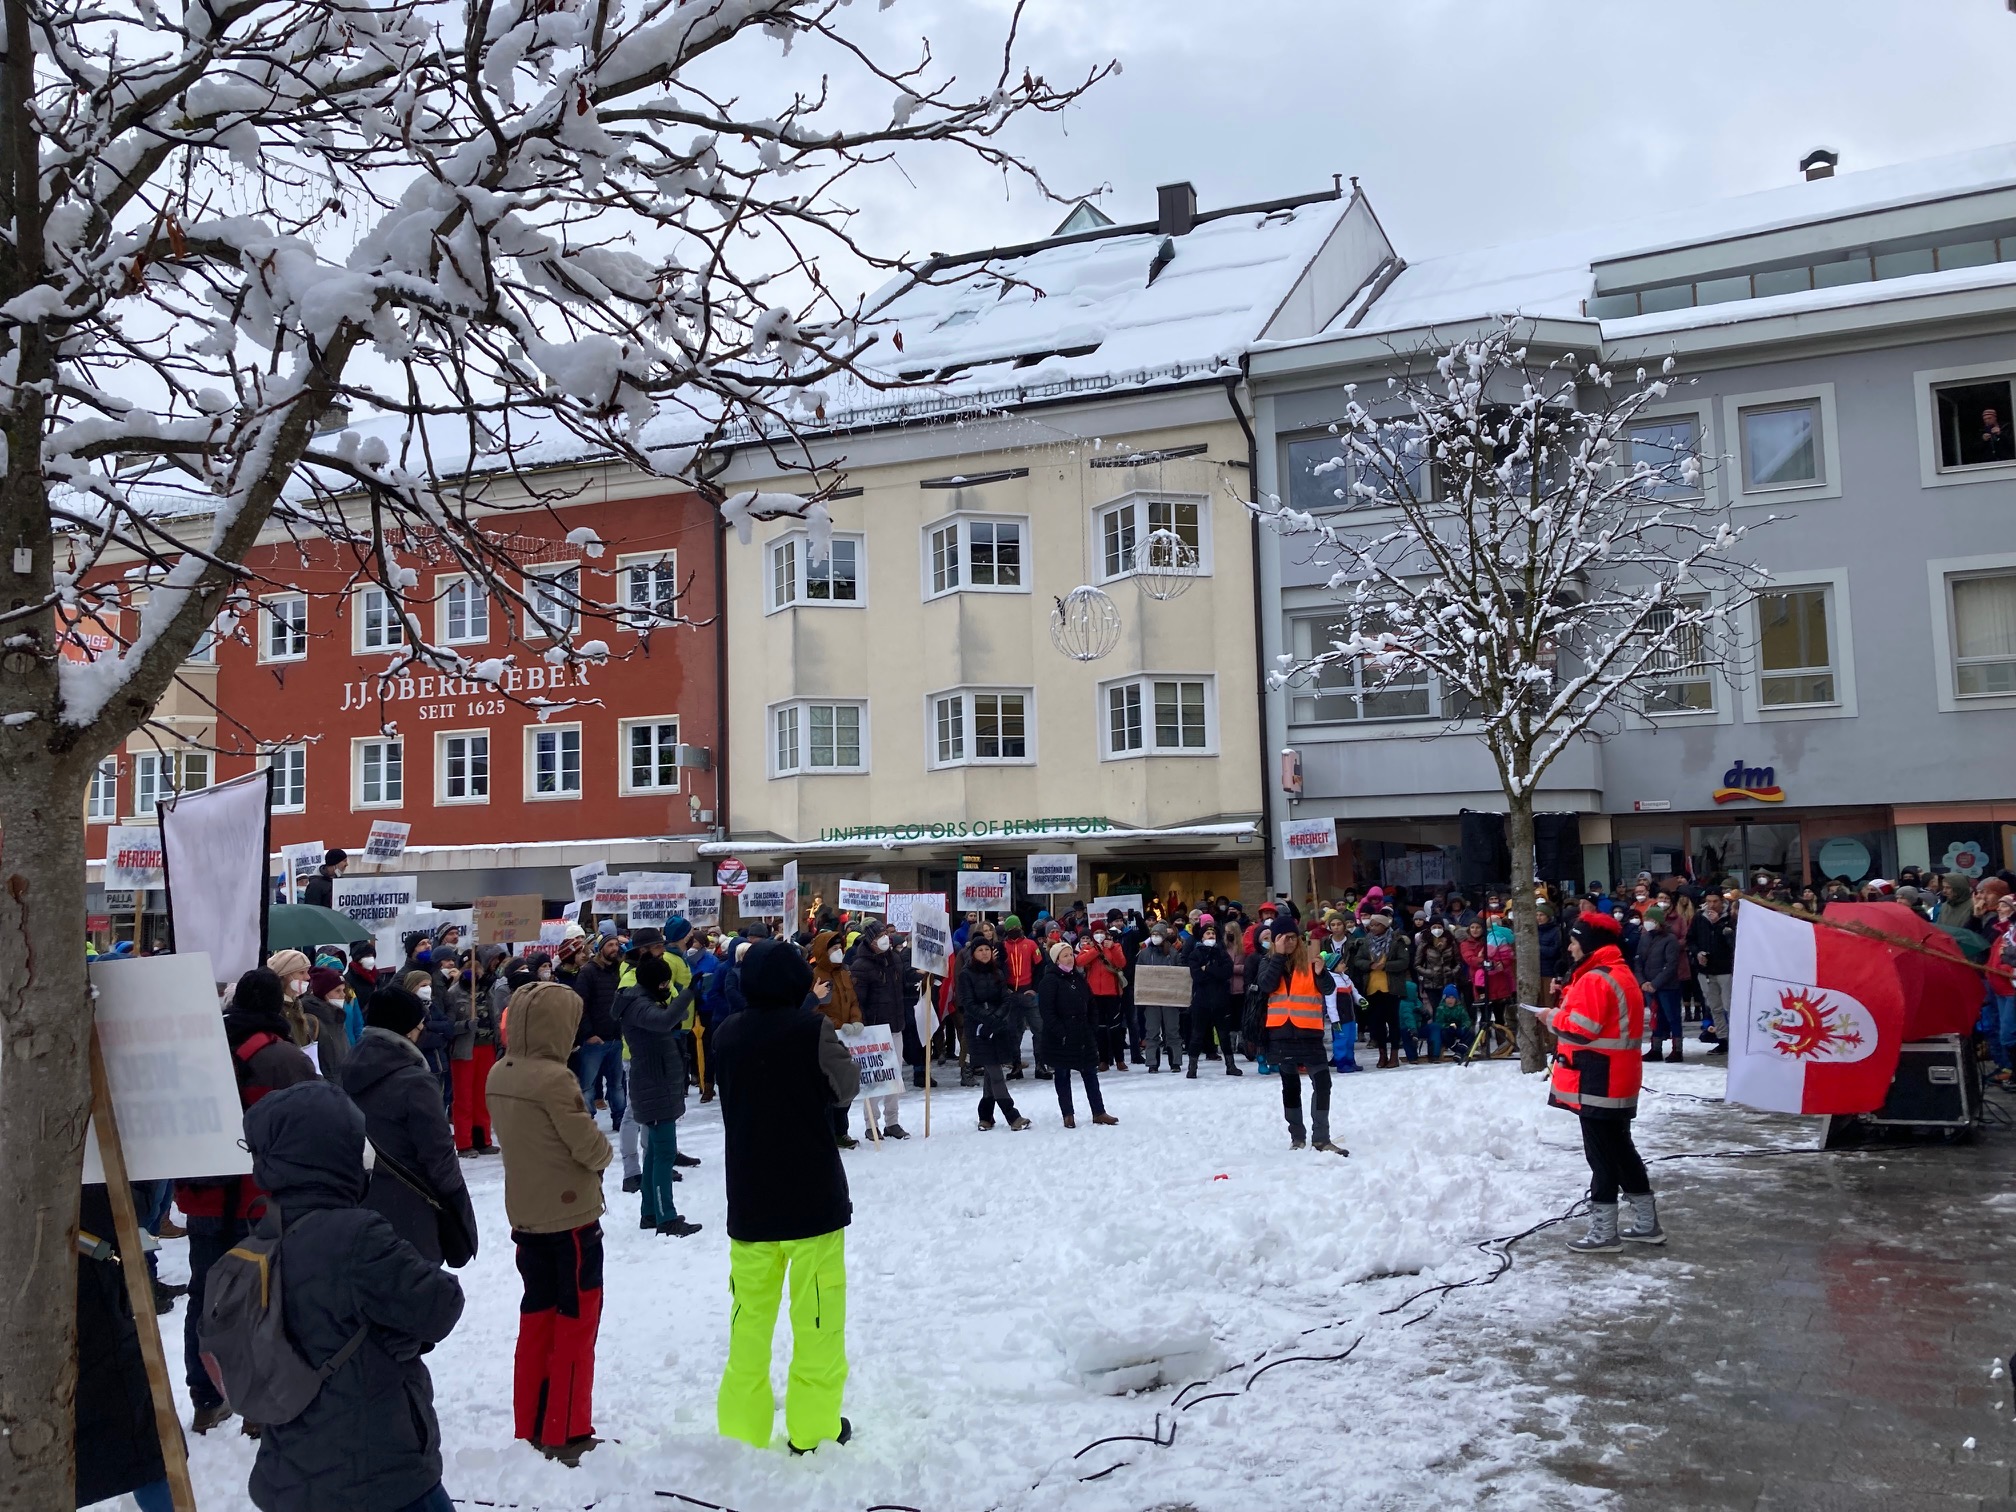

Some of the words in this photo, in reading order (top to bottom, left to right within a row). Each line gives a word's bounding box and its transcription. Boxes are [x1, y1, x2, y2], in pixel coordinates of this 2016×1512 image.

[340, 681, 372, 711] J.J.
[419, 703, 457, 720] SEIT
[468, 700, 506, 717] 1625
[1723, 760, 1775, 788] dm
[820, 825, 888, 842] UNITED
[893, 821, 968, 840] COLORS
[972, 820, 999, 836] OF
[1003, 816, 1108, 836] BENETTON
[1289, 832, 1329, 846] #FREIHEIT
[1032, 866, 1063, 875] WIDERSTAND
[338, 892, 410, 907] CORONA-KETTEN
[654, 901, 665, 909] IHR
[665, 900, 678, 909] UNS
[688, 899, 702, 907] ENKE,
[702, 898, 716, 906] ALSO
[349, 906, 398, 920] SPRENGEN!
[632, 911, 642, 920] DIE
[642, 910, 666, 919] FREIHEIT
[492, 928, 518, 941] MIR
[868, 1055, 884, 1067] UNS
[873, 1068, 895, 1083] KLAUT
